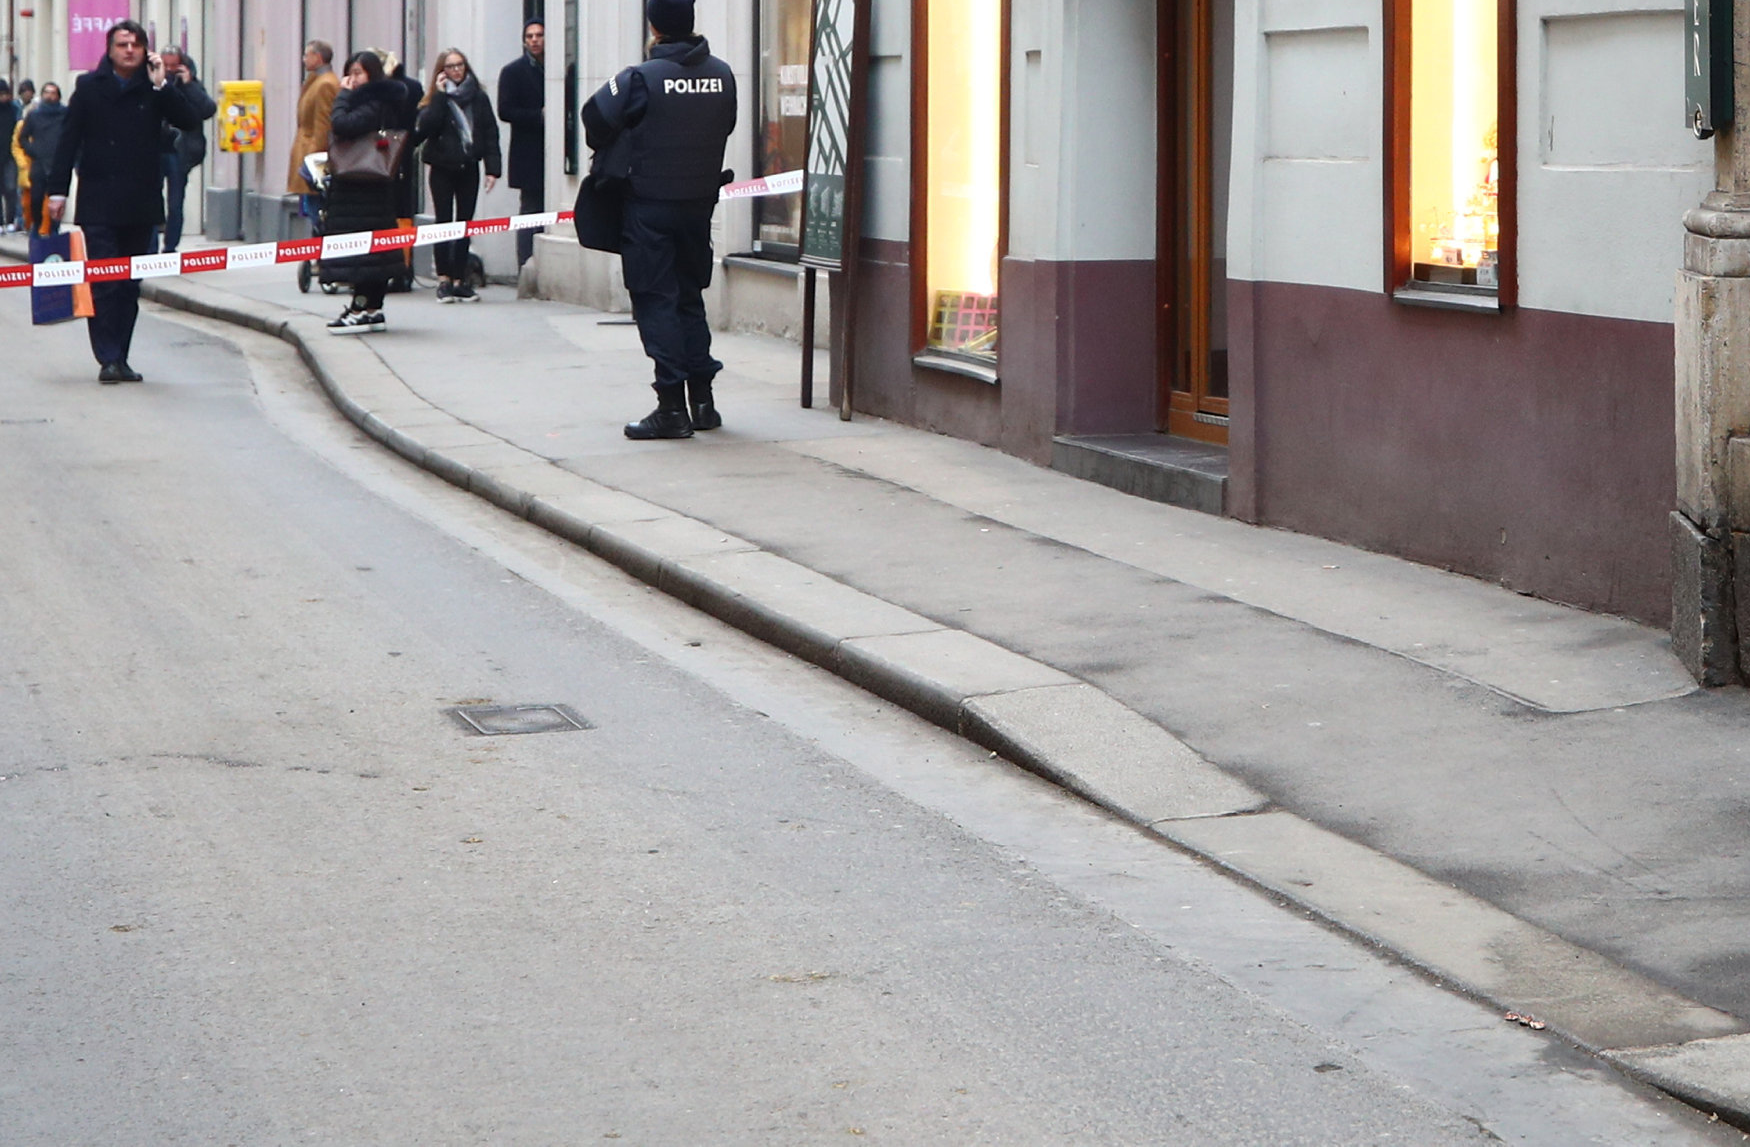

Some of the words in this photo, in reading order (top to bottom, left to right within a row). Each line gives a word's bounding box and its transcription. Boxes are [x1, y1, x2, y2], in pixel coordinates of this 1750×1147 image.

[664, 78, 723, 94] POLIZEI
[0, 271, 27, 283] OLIZEI
[38, 269, 76, 279] POLIZEI
[87, 265, 121, 275] POLIZEI
[135, 261, 173, 271] POLIZEI
[183, 257, 219, 268] POLIZEI
[231, 252, 268, 262] POLIZEI
[279, 246, 315, 257] POLIZEI
[327, 240, 363, 251] POLIZEI
[374, 235, 410, 246] POLIZEI
[421, 230, 457, 240] POLIZEI
[467, 224, 503, 235] POLIZEI
